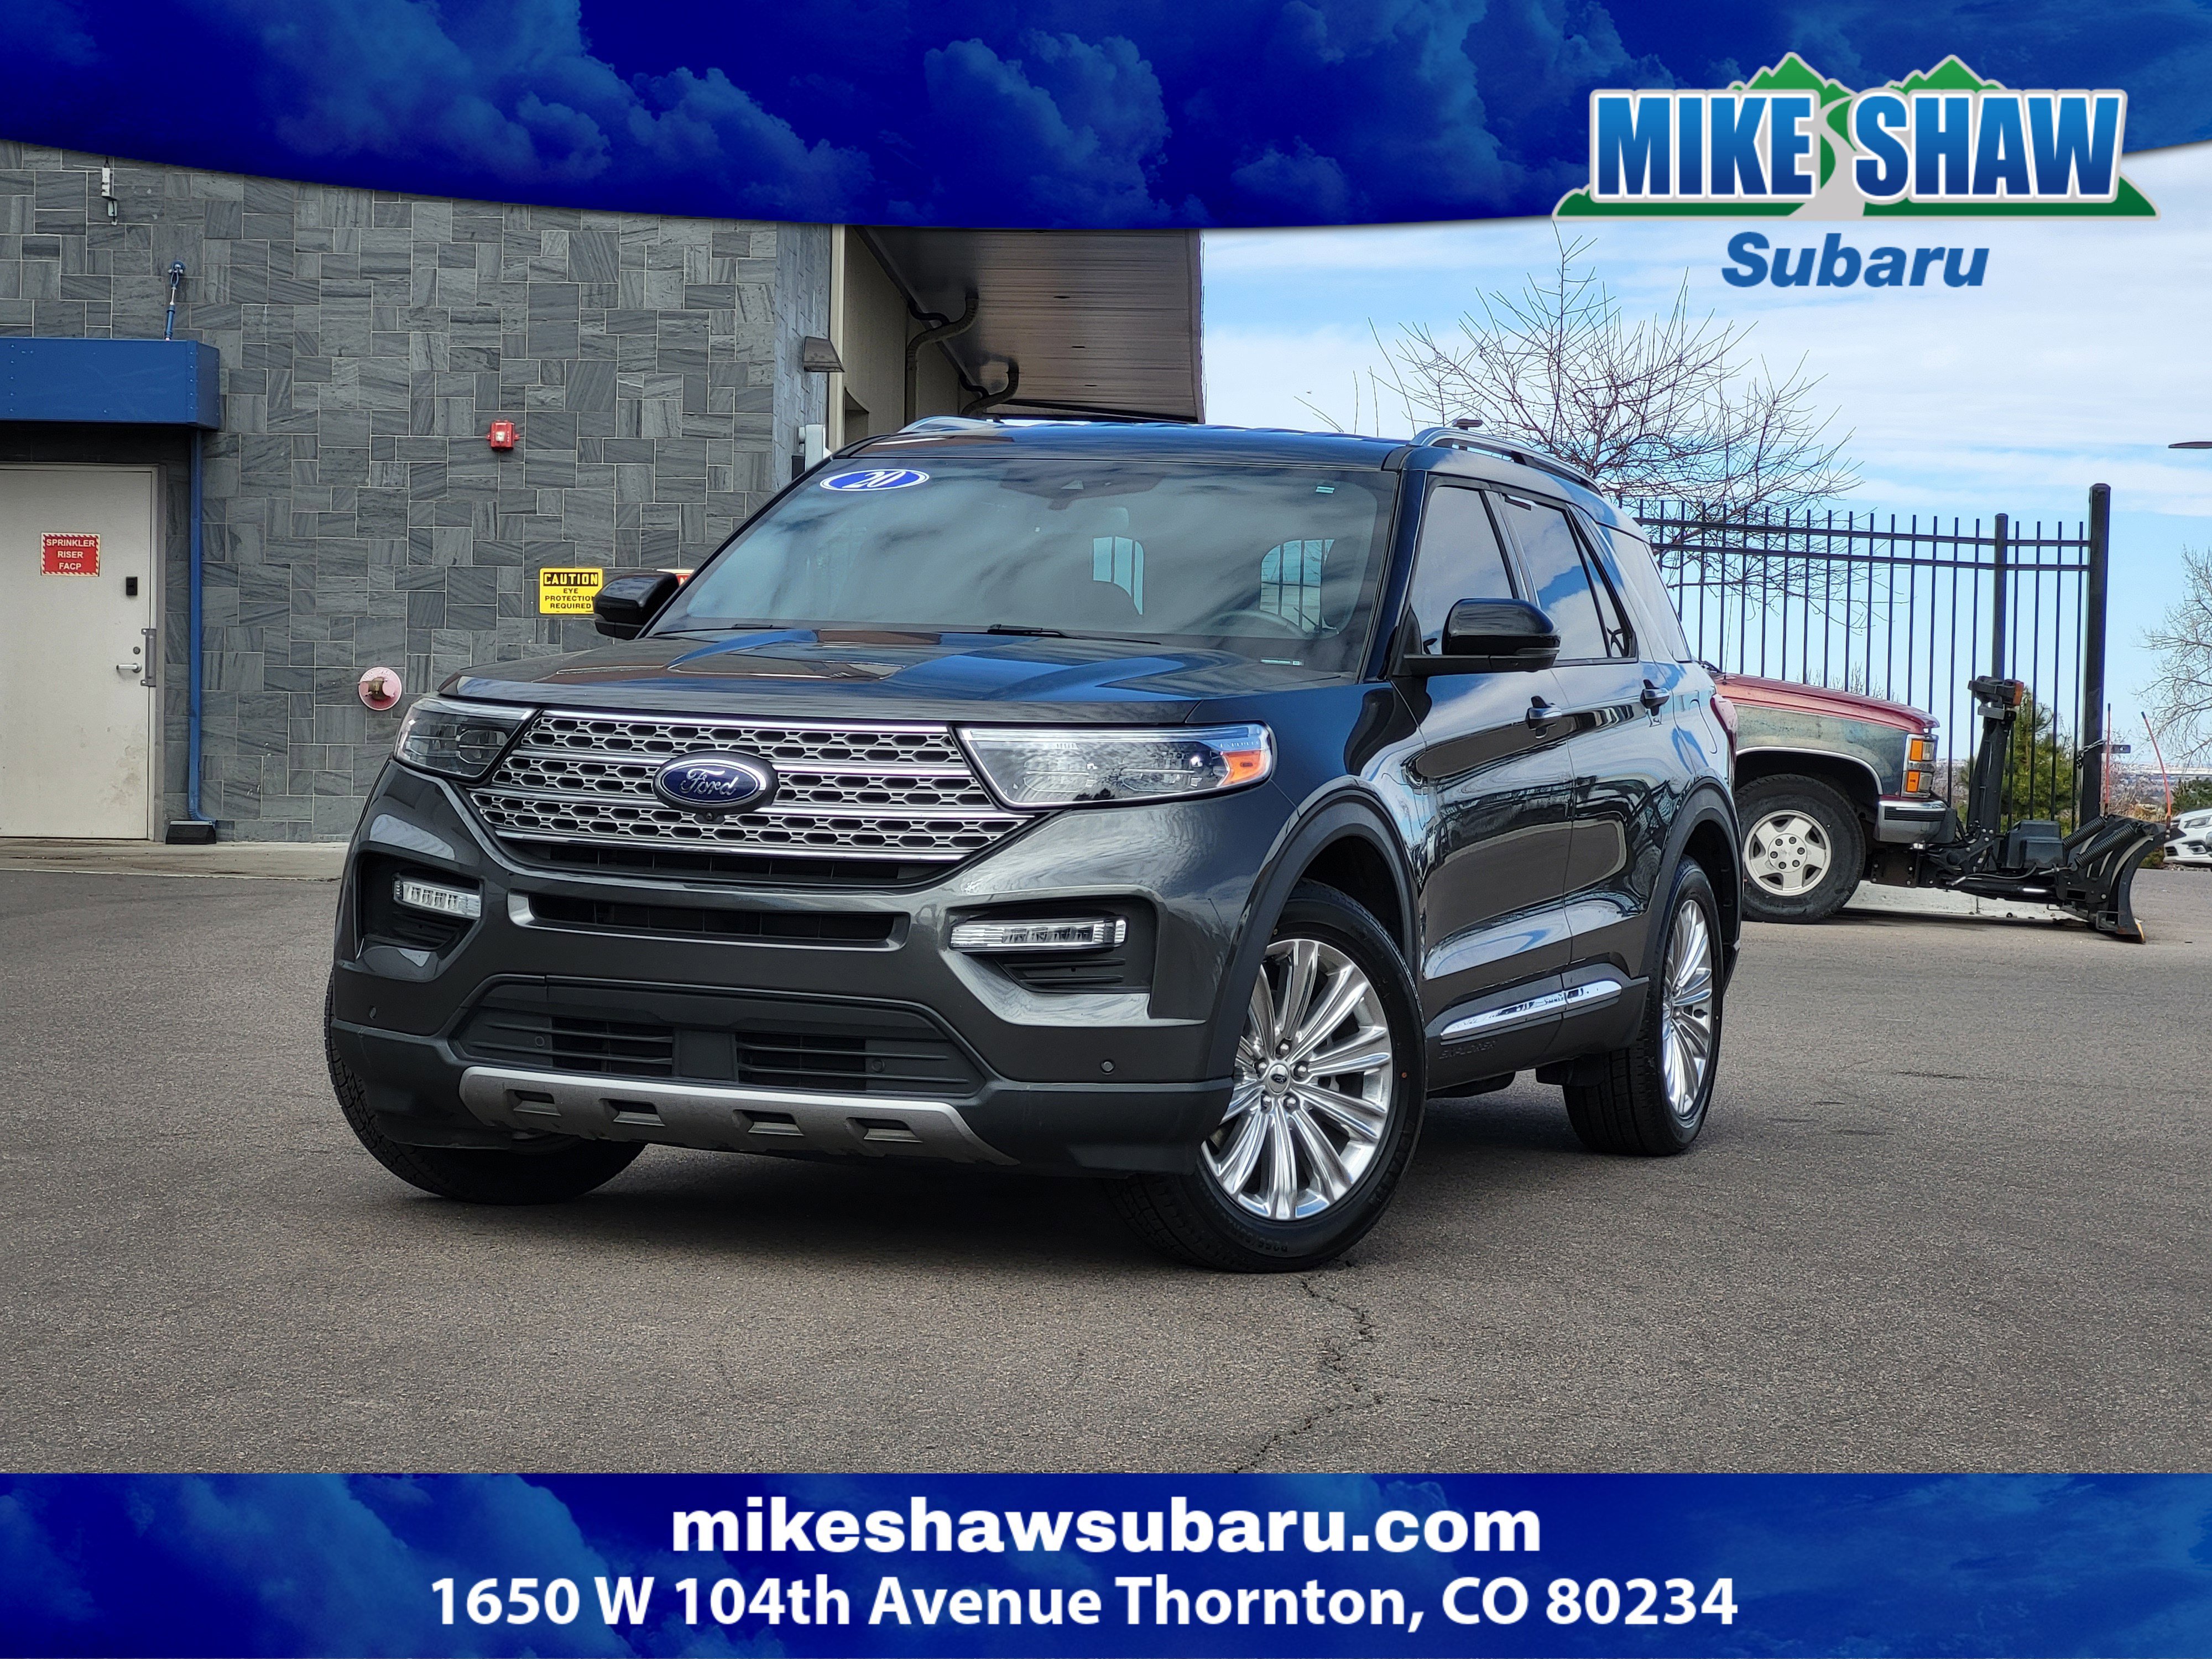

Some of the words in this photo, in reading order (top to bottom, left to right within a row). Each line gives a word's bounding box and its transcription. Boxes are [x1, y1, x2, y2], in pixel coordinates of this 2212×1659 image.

[841, 470, 906, 489] 20
[45, 539, 96, 547] SPRINKLER
[57, 550, 84, 559] RISER
[544, 573, 598, 585] CAUTION
[679, 768, 739, 796] Ford
